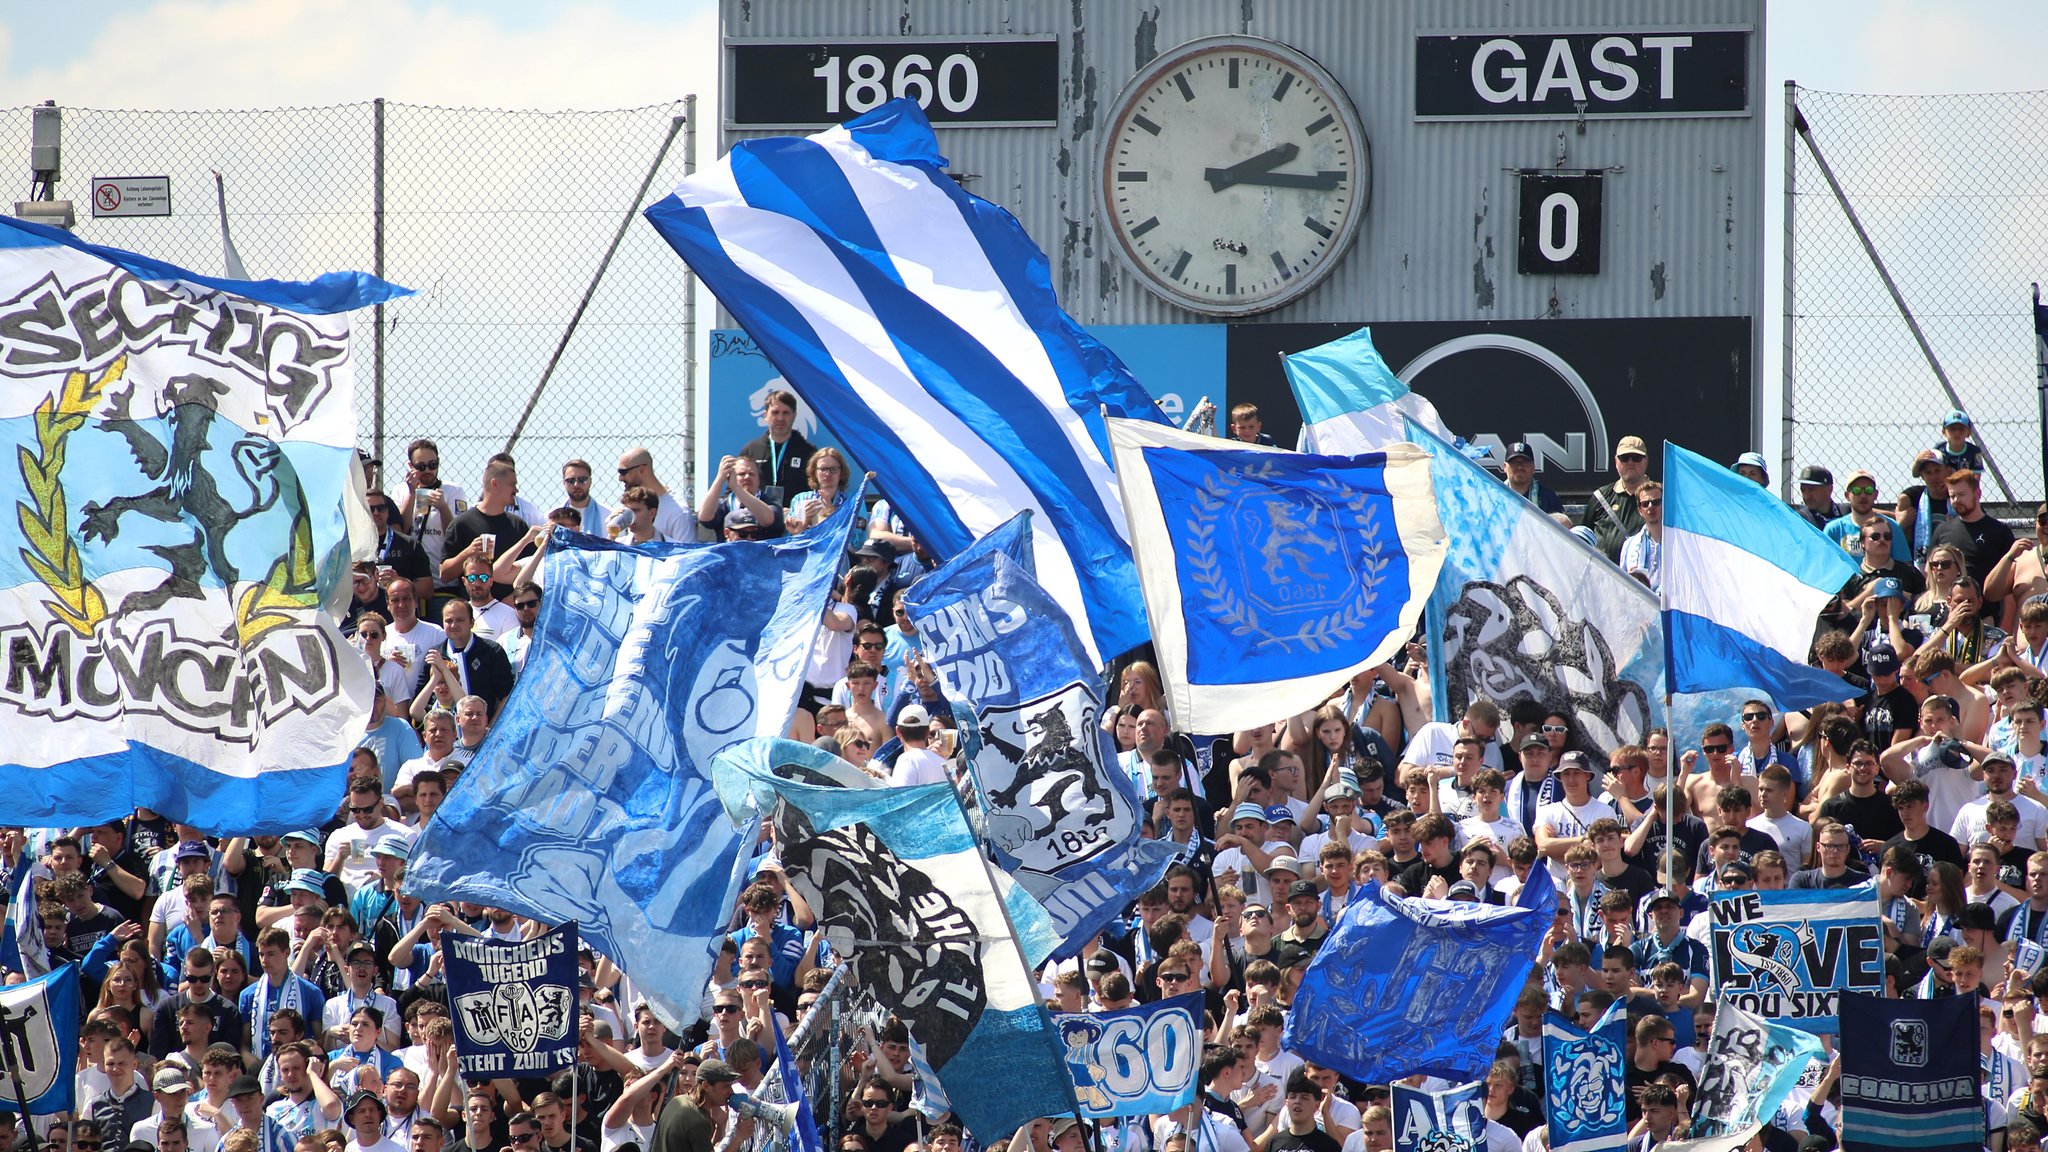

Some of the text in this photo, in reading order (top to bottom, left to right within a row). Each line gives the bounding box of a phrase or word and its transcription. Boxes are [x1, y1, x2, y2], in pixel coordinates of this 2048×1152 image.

[814, 53, 978, 114] 1860
[1471, 36, 1693, 104] GAST
[1538, 192, 1580, 262] 0
[1469, 432, 1587, 473] AN
[1711, 893, 1764, 926] WE
[453, 932, 565, 964] MÜNCHENS
[478, 958, 548, 984] JUGEND
[1760, 957, 1792, 986] TSV 1860
[503, 1027, 533, 1049] 1860
[1097, 1008, 1195, 1098] 60
[457, 1052, 507, 1074] STEHT
[513, 1052, 549, 1071] ZUM
[1841, 1075, 1975, 1104] COMITIVA
